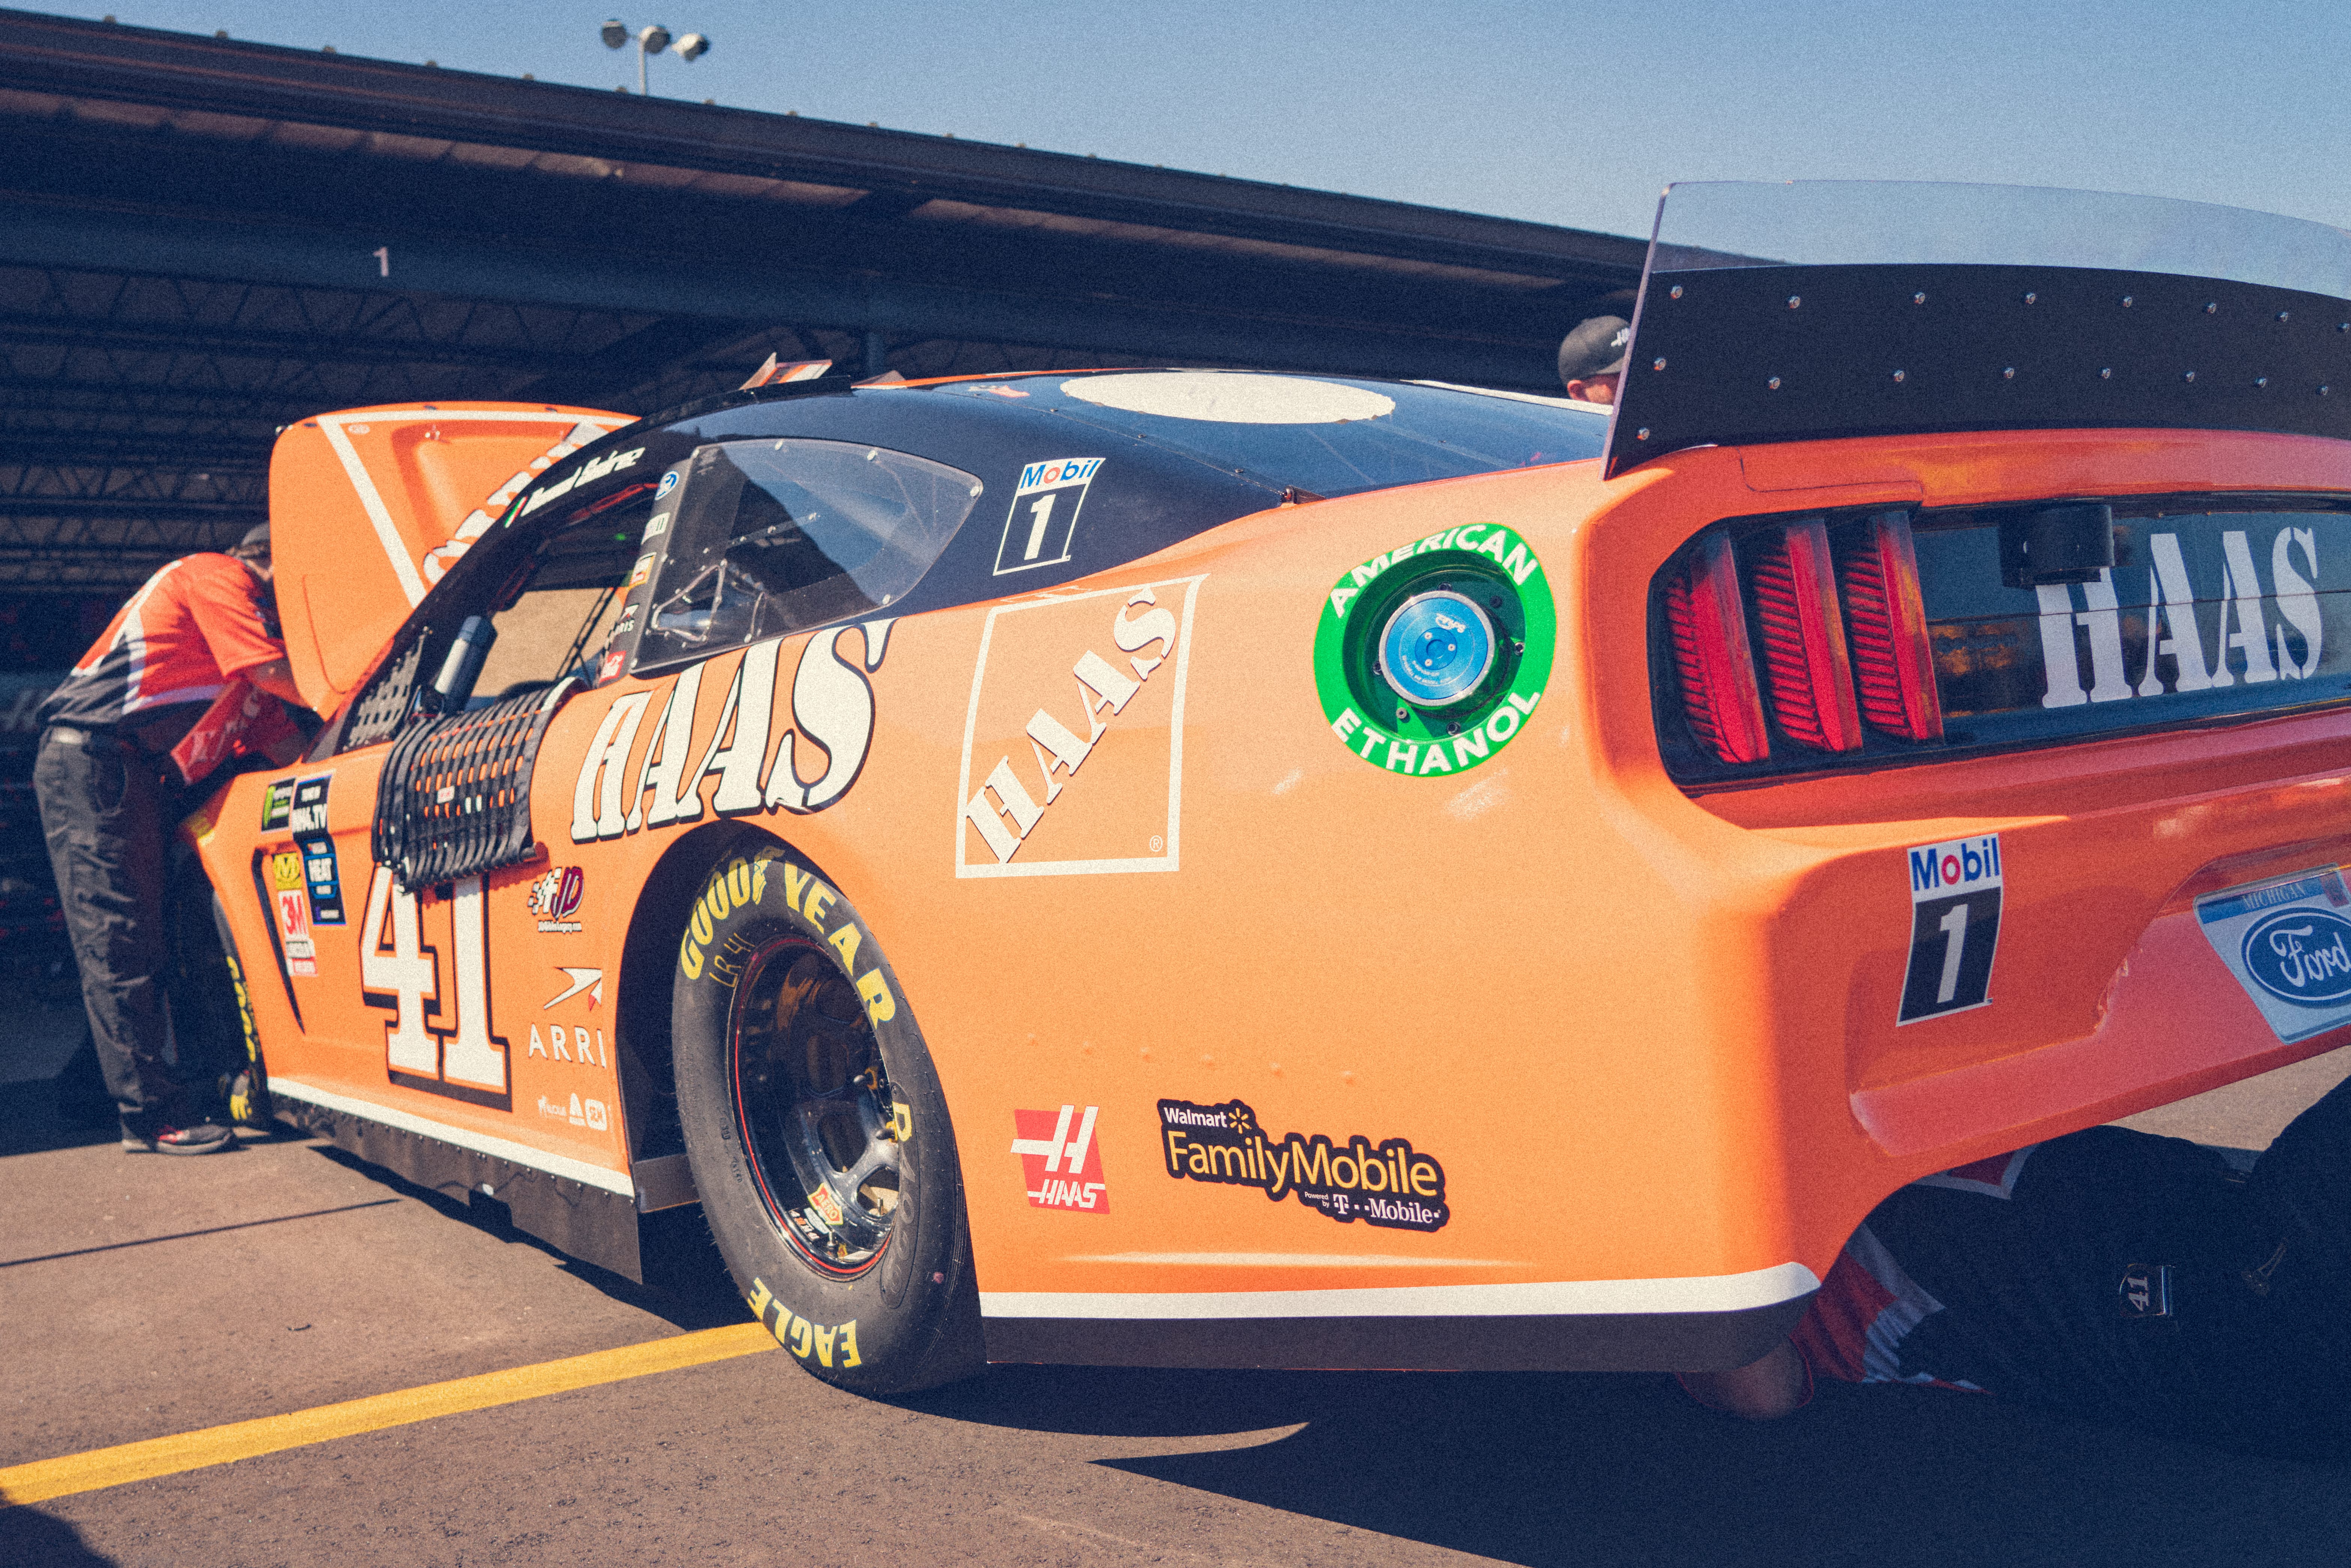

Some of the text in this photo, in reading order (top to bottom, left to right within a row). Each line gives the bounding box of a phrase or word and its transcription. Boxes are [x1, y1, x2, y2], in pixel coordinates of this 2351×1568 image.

[372, 246, 389, 277] 1
[1020, 460, 1100, 489] Mobil
[1024, 494, 1056, 560] 1
[1330, 524, 1538, 619] AMERICAN
[2036, 526, 2322, 709] HAAS
[571, 618, 898, 843] HAAS
[965, 586, 1177, 864] HAAS
[1331, 691, 1541, 774] ETHANOL
[1910, 837, 2000, 891] Mobil
[282, 895, 307, 934] 3M
[2241, 882, 2306, 910] MICHIGAN
[1937, 903, 1968, 1003] 1
[2269, 925, 2351, 987] Ford
[359, 866, 512, 1111] 41
[1163, 1107, 1228, 1128] Walmart
[814, 1194, 838, 1220] AERO
[1027, 1178, 1106, 1209] HAAS
[1304, 1191, 1329, 1200] Powered
[1322, 1200, 1330, 1208] by
[2127, 1276, 2149, 1311] 41
[747, 1277, 862, 1368] EAGLE
